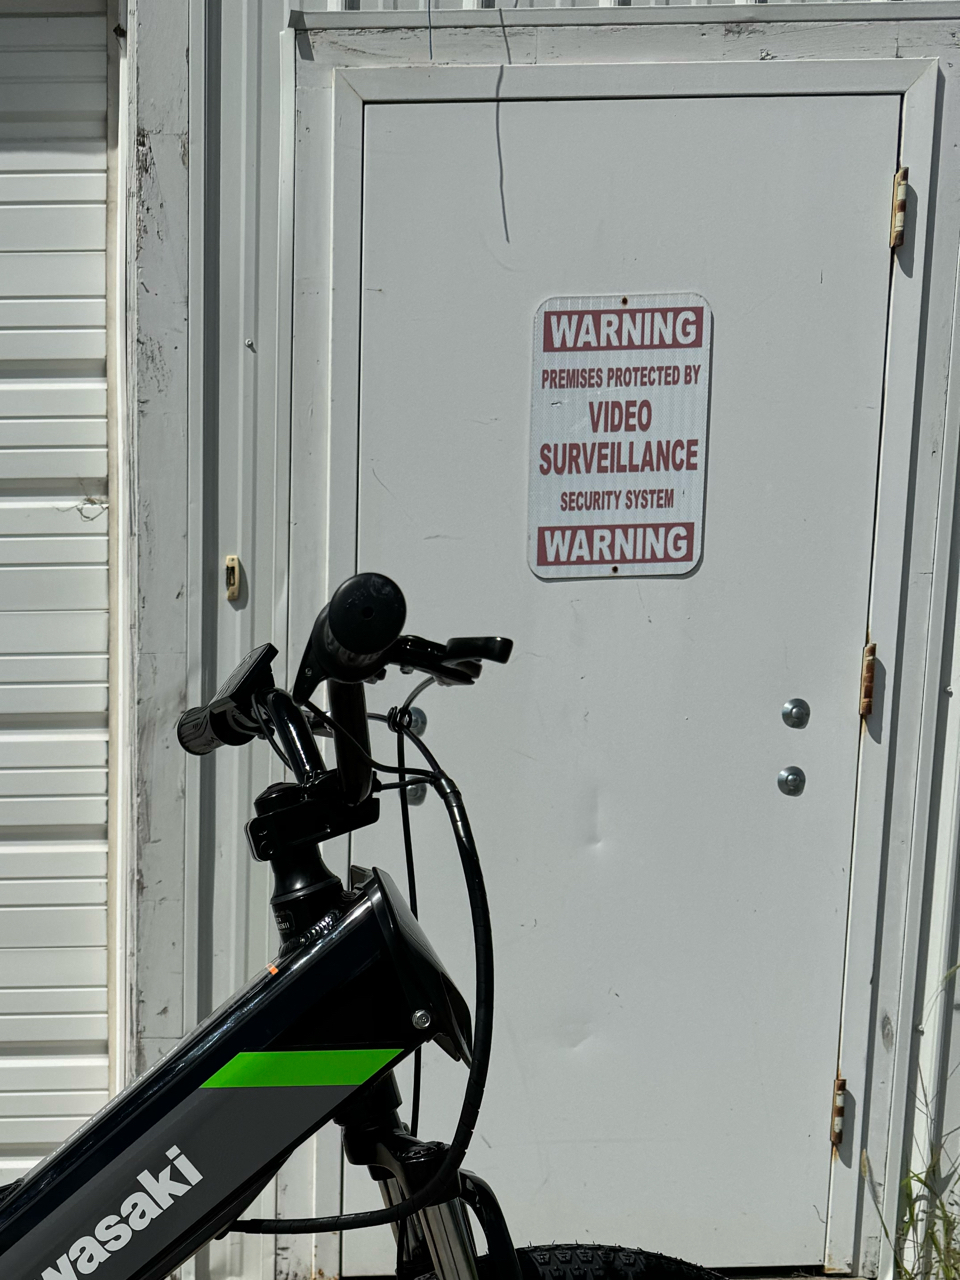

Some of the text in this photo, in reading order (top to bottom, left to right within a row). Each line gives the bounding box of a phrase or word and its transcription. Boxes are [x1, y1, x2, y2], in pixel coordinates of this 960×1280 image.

[550, 310, 697, 348] WARNING
[541, 364, 701, 389] PREMISES PROTECTED BY
[589, 399, 652, 433] VIDEO
[540, 439, 699, 476] SURVEILLANCE
[560, 488, 675, 512] SECURITY SYSTEM
[544, 526, 688, 563] WARNING
